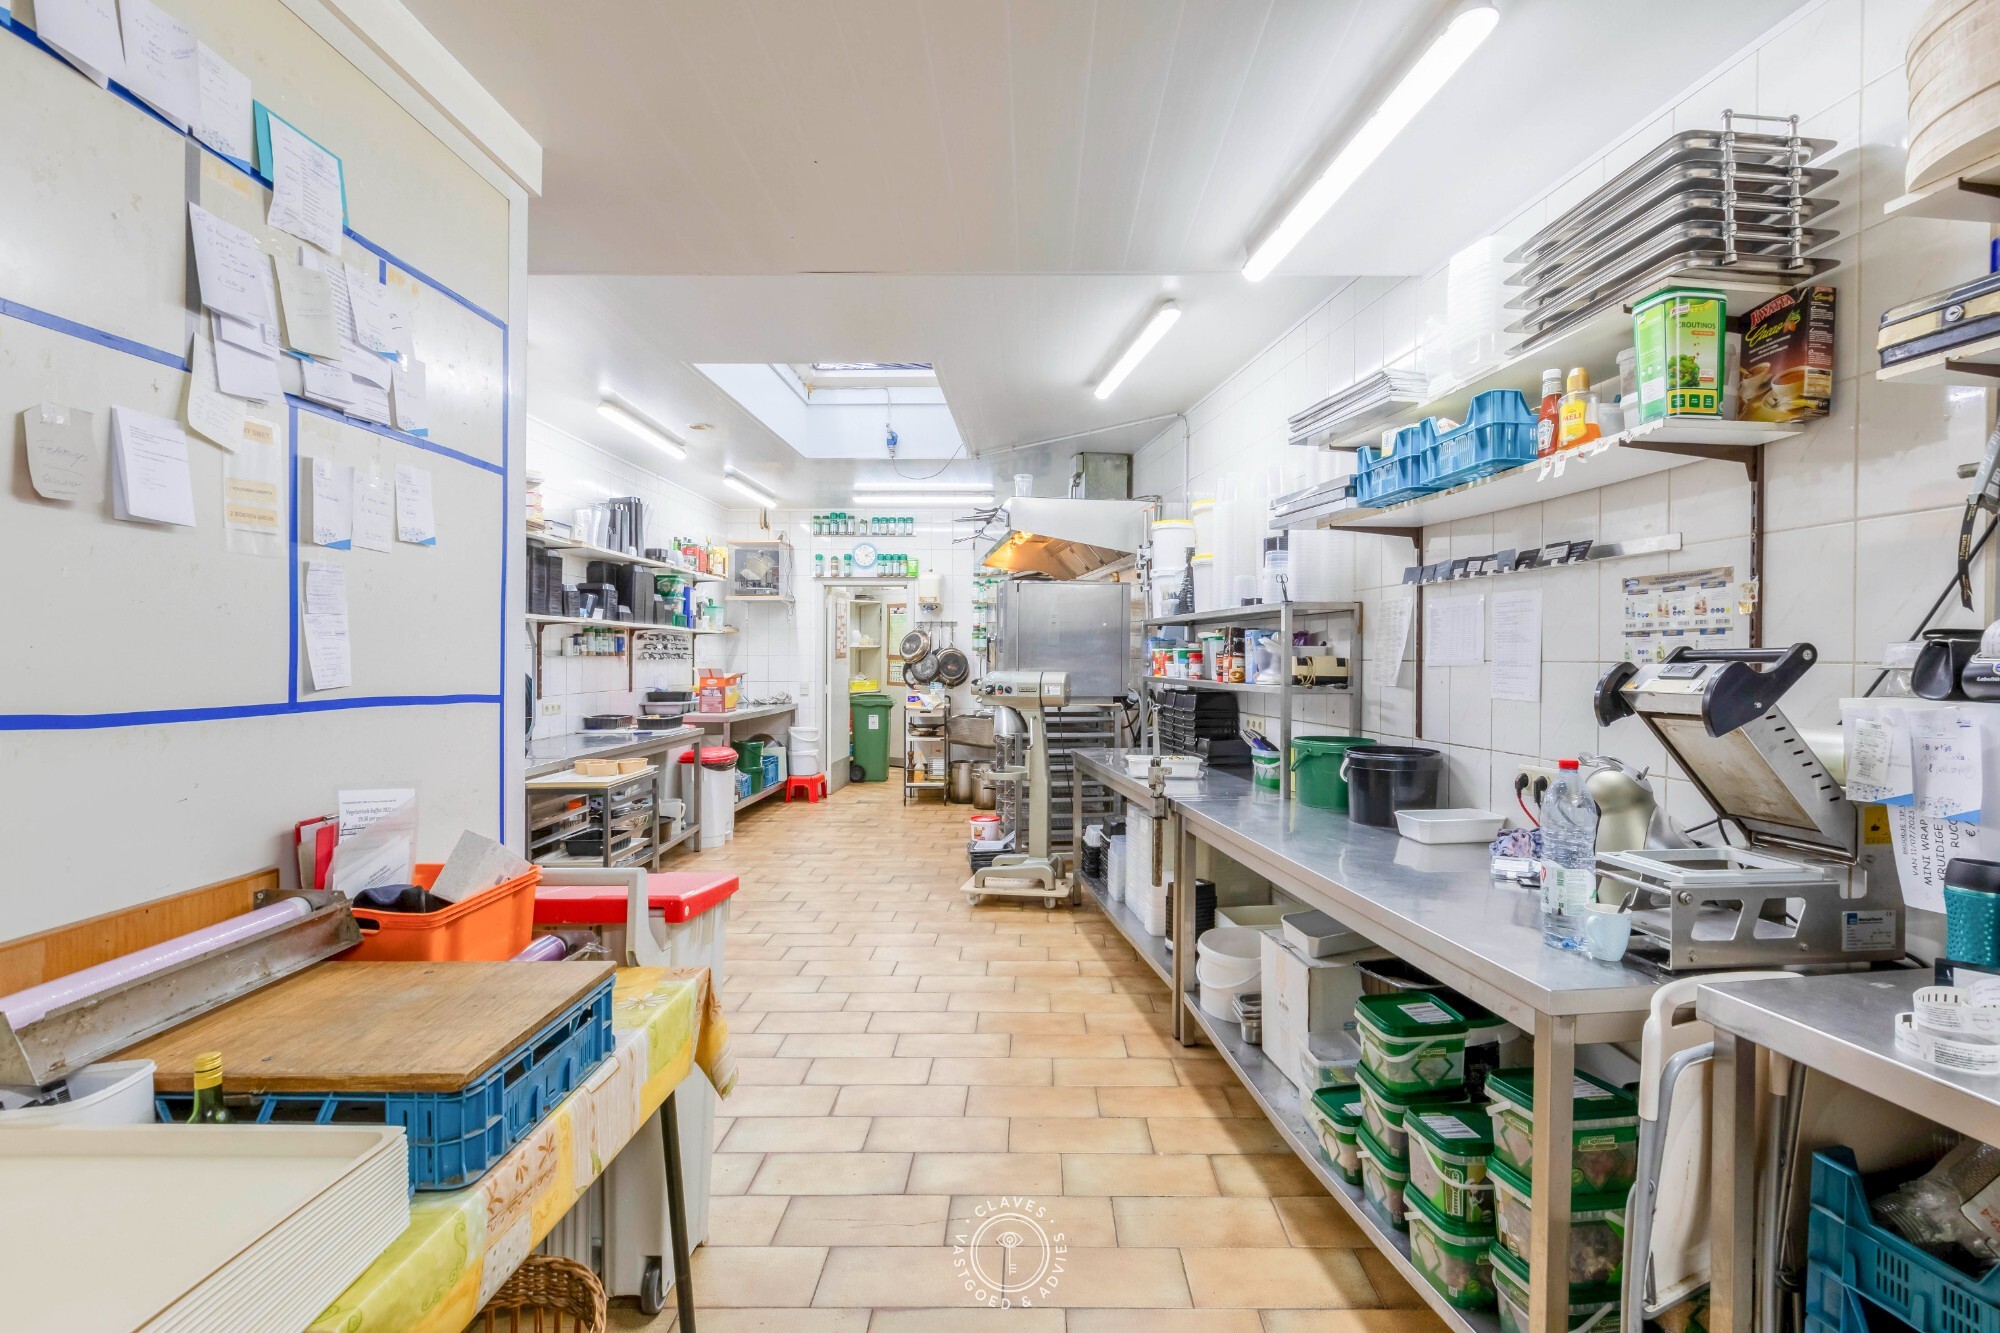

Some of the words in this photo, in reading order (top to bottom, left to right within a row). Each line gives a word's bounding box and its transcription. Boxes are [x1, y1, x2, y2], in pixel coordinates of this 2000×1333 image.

[1676, 321, 1716, 330] CROUTINOS
[1751, 294, 1795, 328] KWATTA
[1745, 321, 1785, 347] Cacao
[1562, 412, 1582, 422] MELI
[1908, 810, 1917, 855] 11/07/2023
[1920, 818, 1930, 851] WRAP
[1933, 824, 1946, 881] KRUIDIGE
[1922, 855, 1932, 886] MINI
